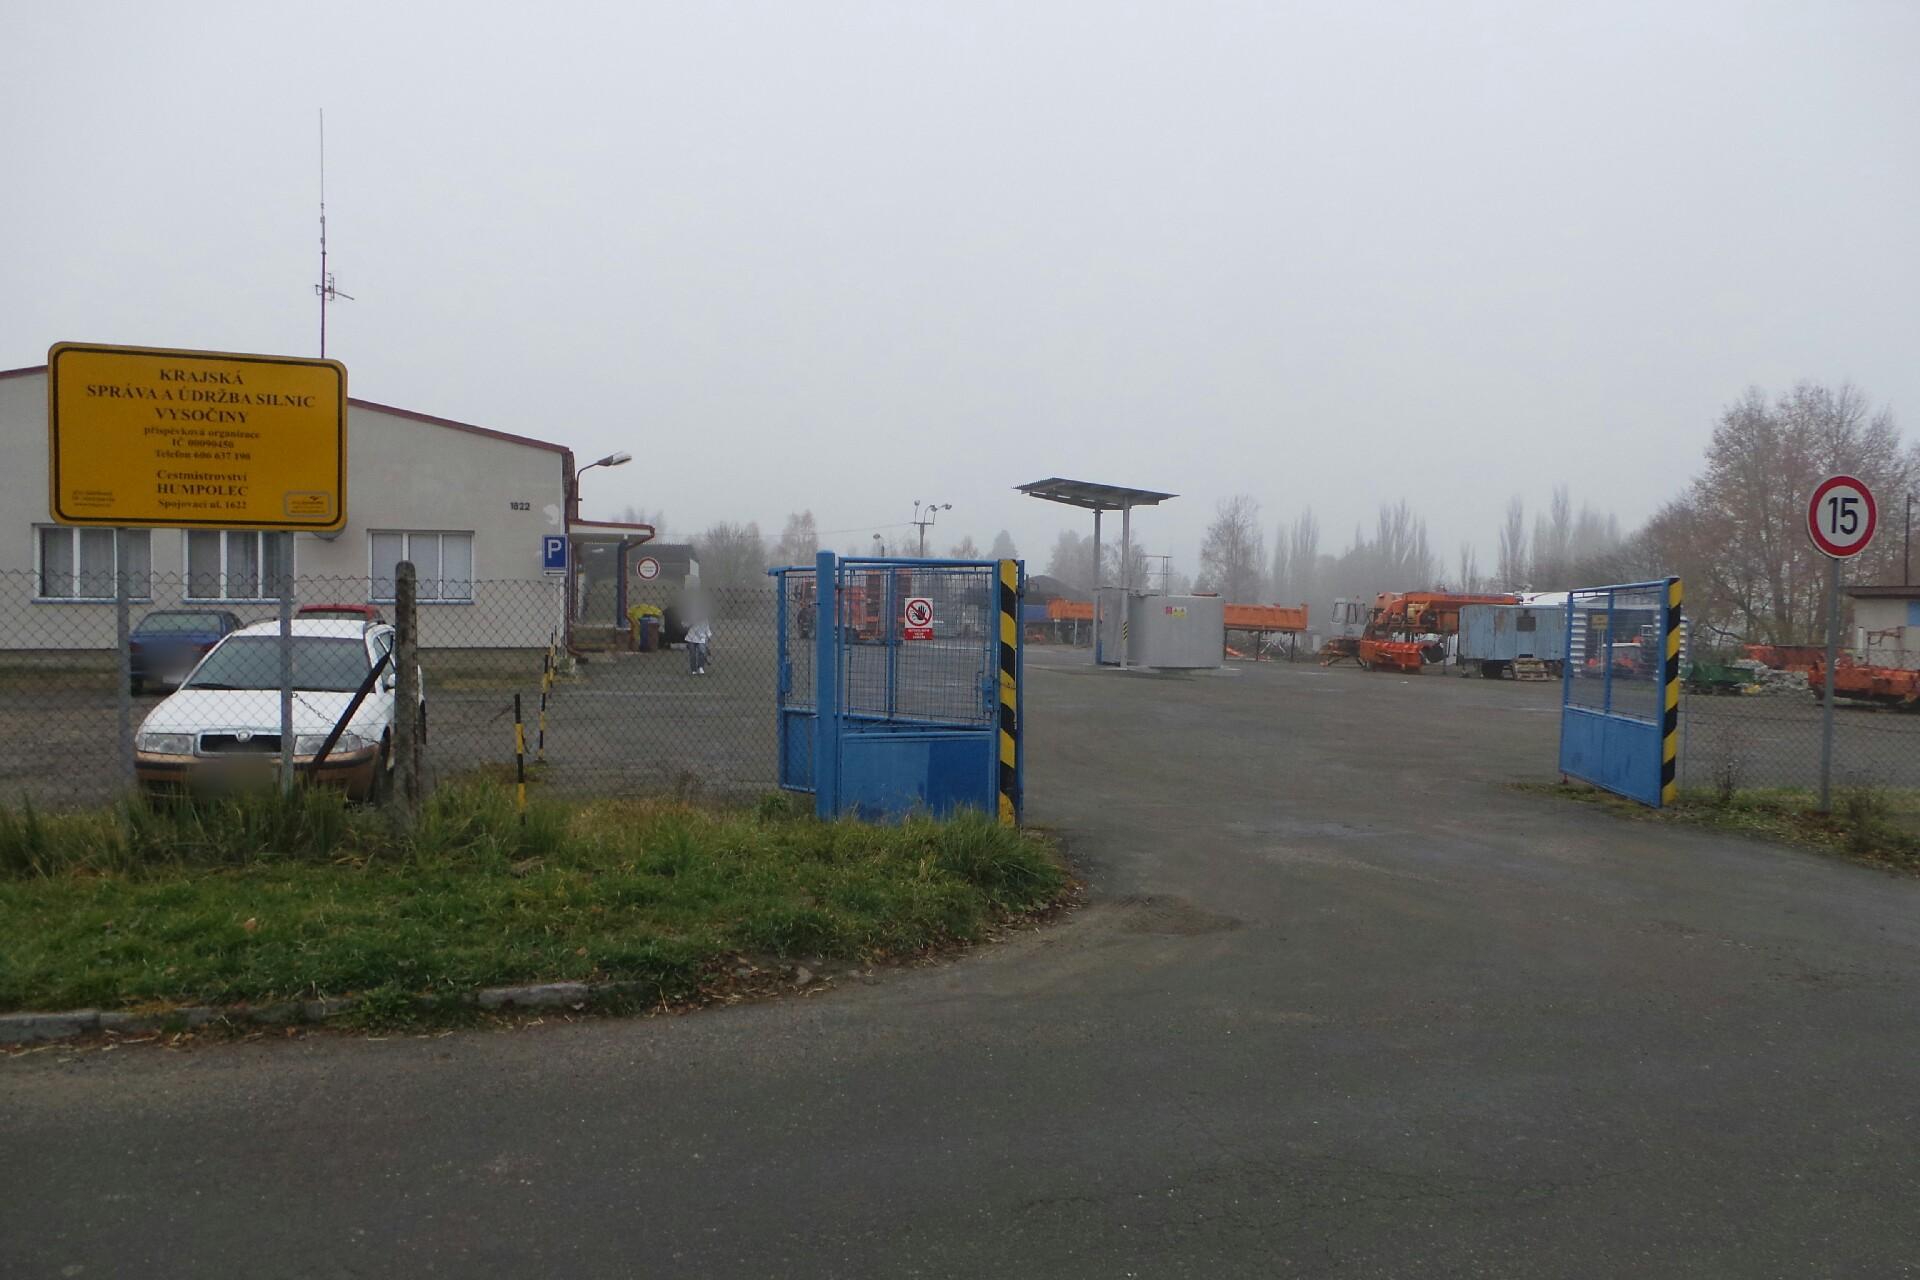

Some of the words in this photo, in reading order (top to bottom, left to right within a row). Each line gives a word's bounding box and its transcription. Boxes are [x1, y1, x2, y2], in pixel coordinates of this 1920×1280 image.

[160, 369, 244, 385] KRAJSKÁ
[87, 383, 157, 400] SPRÁVA
[162, 389, 173, 401] A
[178, 386, 252, 405] ÚDRŽBA
[256, 393, 316, 408] SILNIC
[155, 407, 248, 424] VYSOČINY
[208, 430, 260, 440] organizace
[157, 469, 248, 482] Cestmistrovství
[157, 482, 248, 498] HUMPOLEC
[1828, 497, 1859, 535] 15
[547, 539, 563, 559] P
